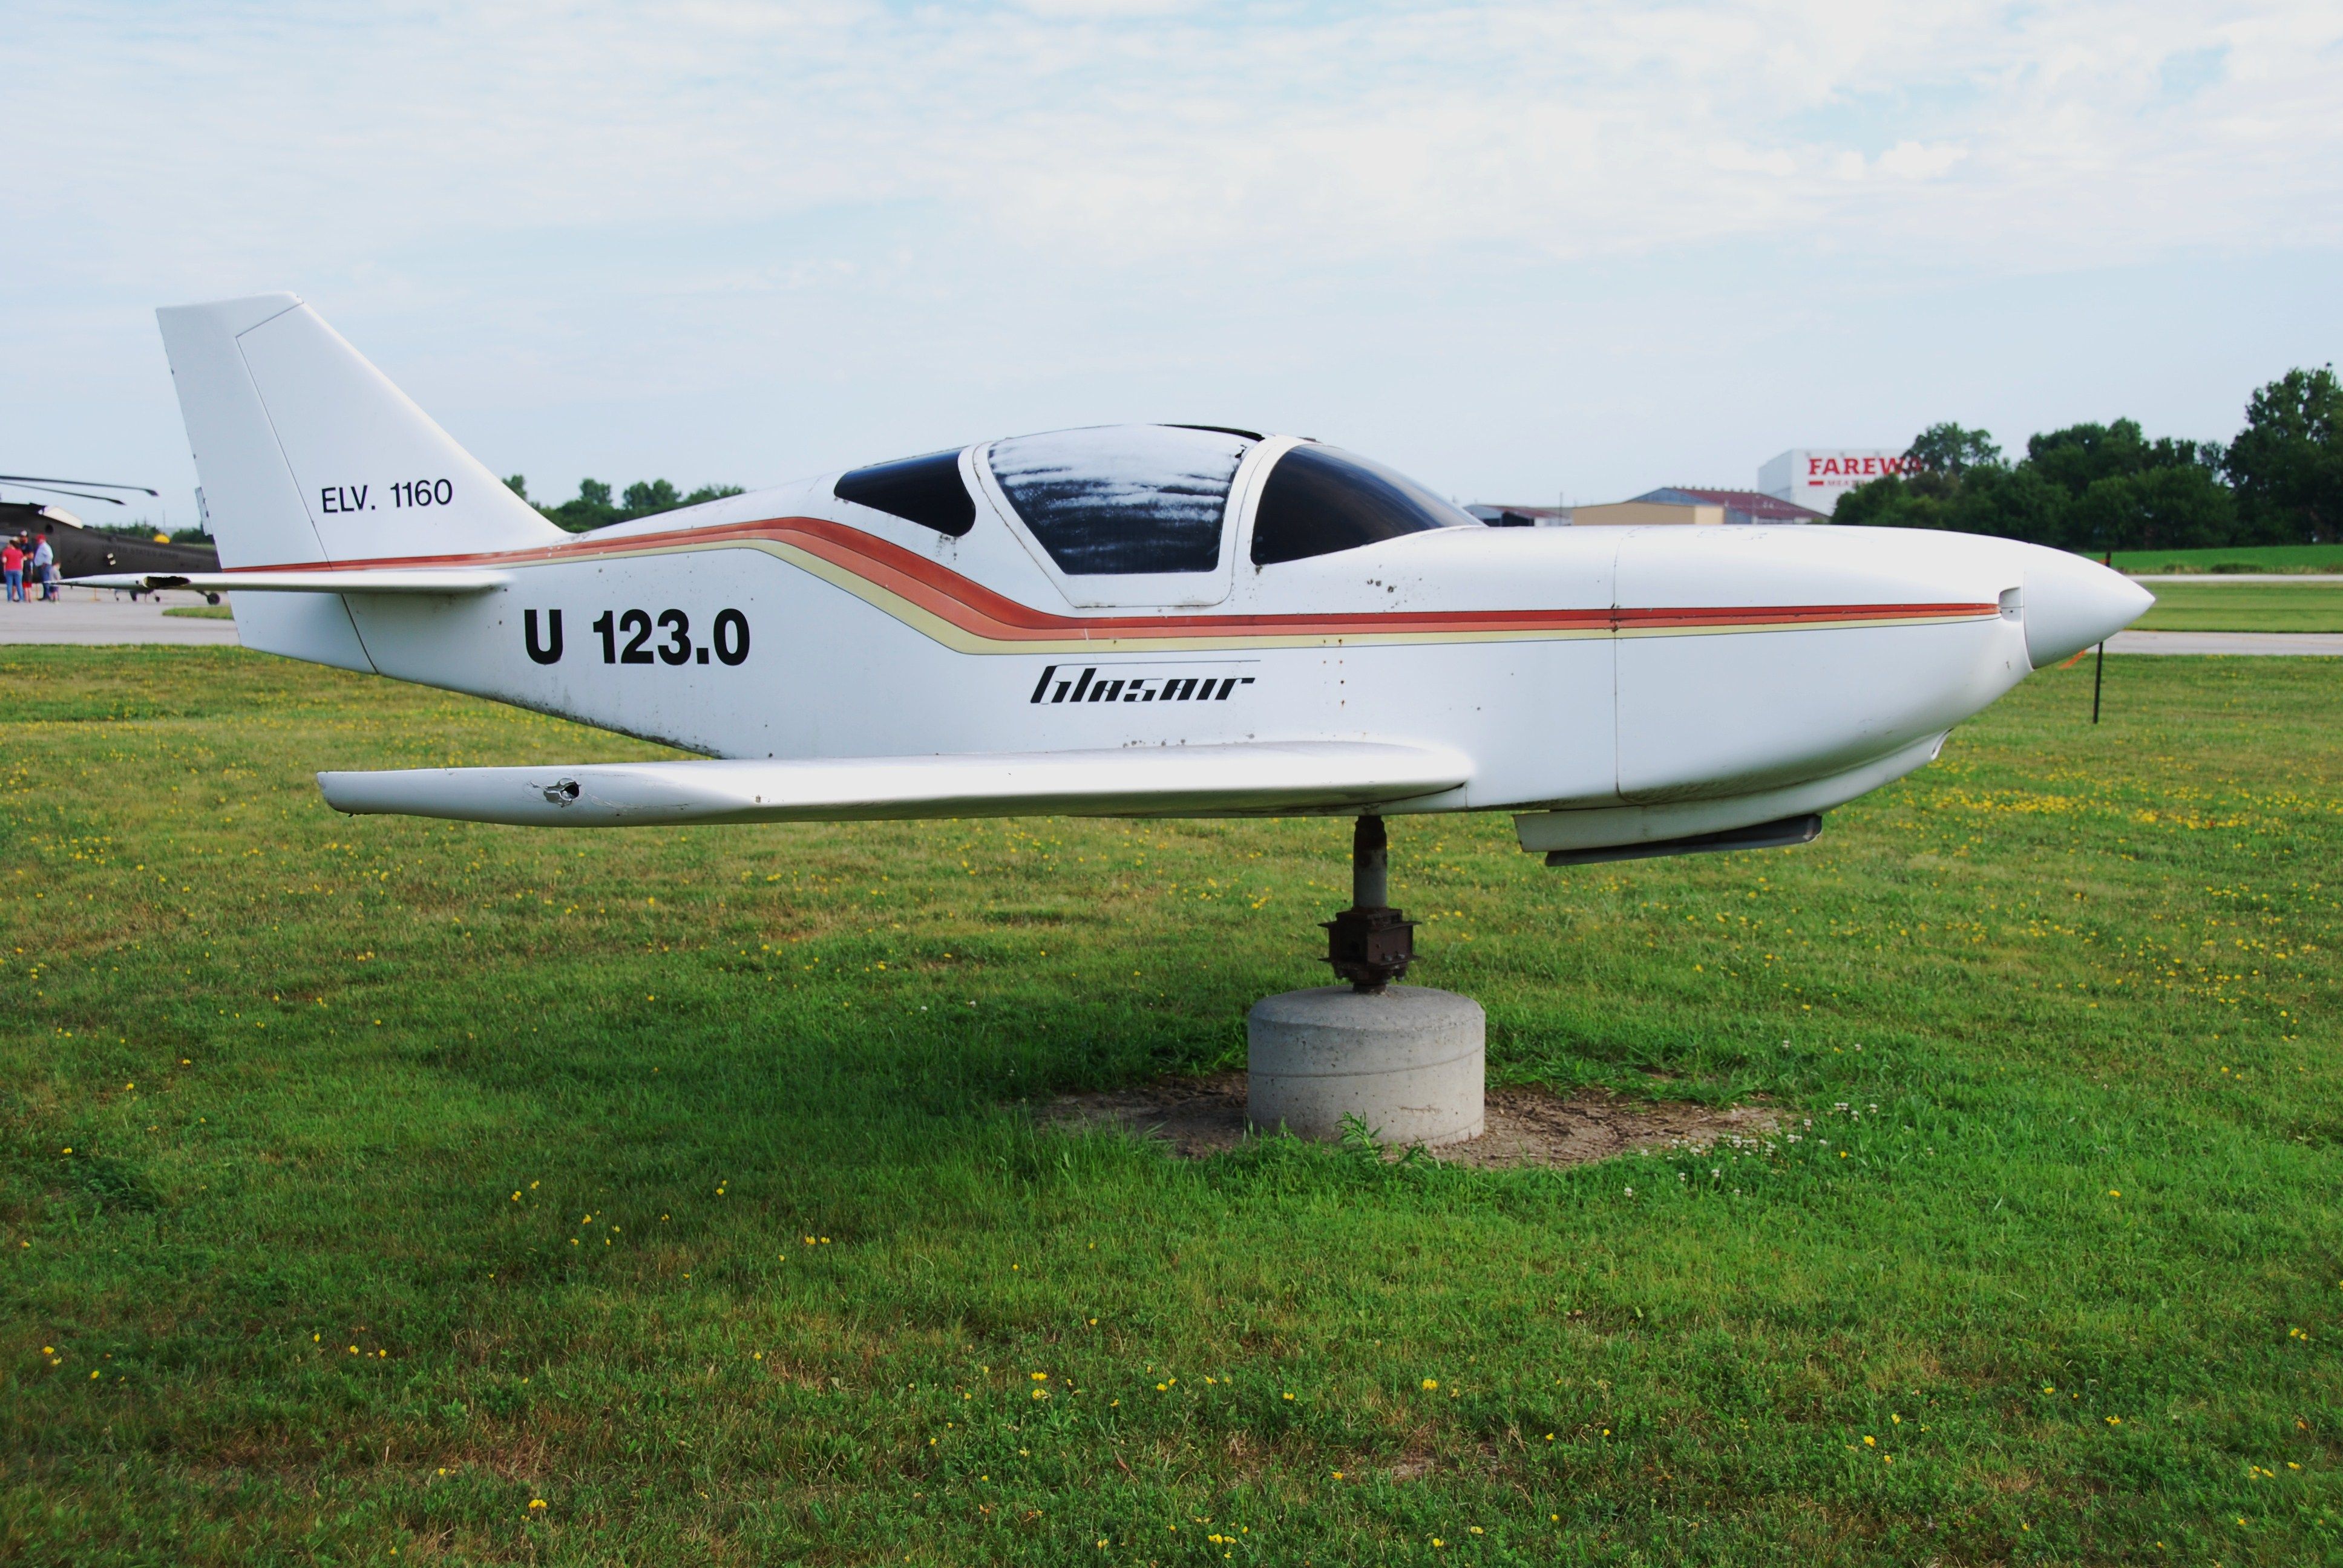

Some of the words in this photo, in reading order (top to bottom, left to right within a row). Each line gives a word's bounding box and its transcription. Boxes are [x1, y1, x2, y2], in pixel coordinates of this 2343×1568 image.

[321, 485, 376, 513] ELV.
[390, 479, 453, 508] 1160
[524, 609, 563, 665] U
[592, 608, 750, 666] 123.0
